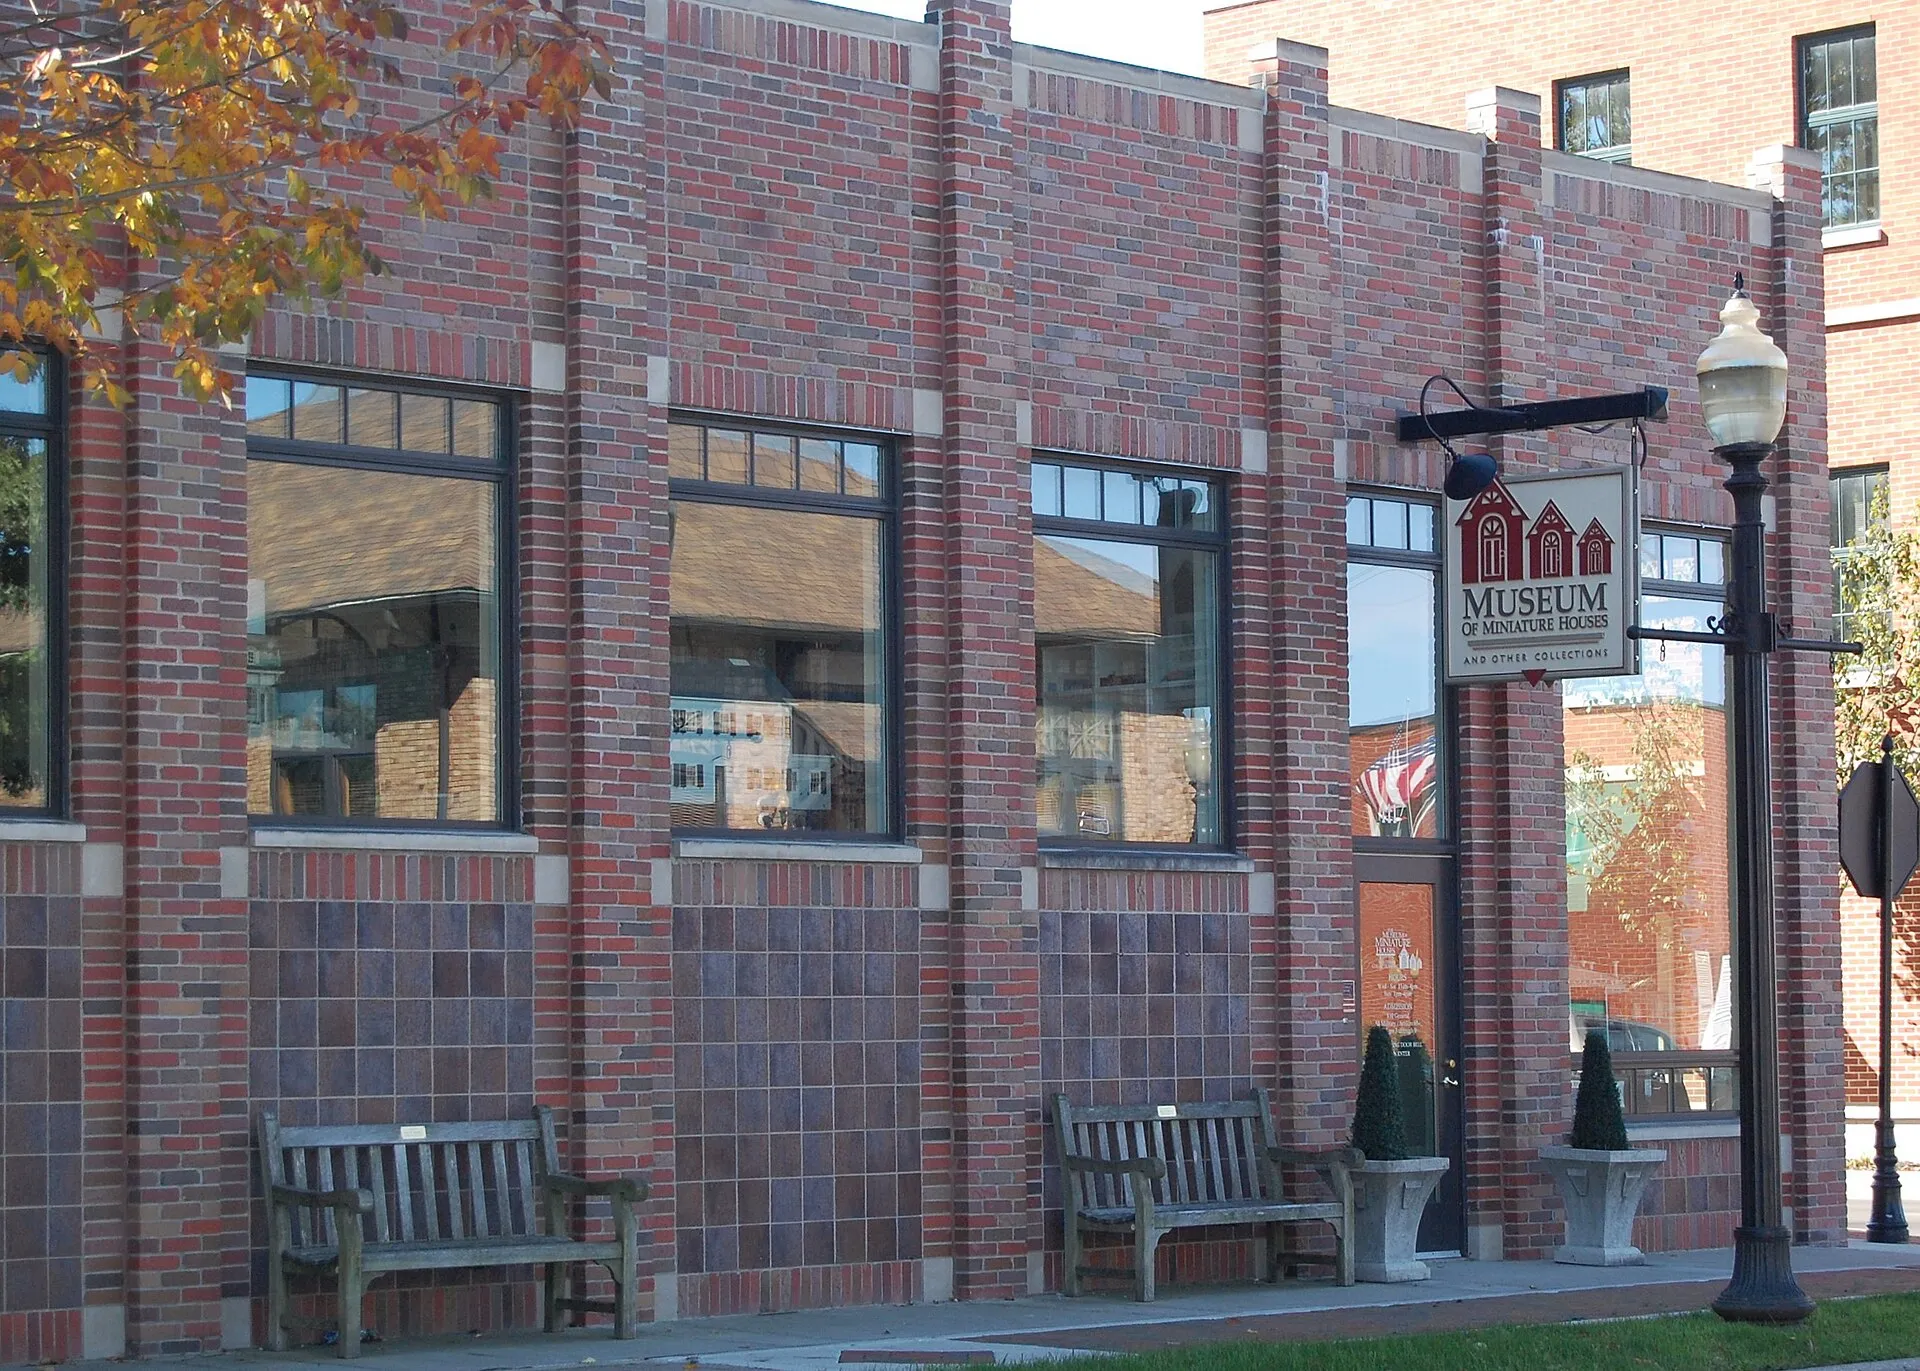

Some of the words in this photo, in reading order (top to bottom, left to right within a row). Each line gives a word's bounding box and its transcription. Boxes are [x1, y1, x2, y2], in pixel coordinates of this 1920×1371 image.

[1462, 583, 1608, 620] MUSEUM
[1462, 622, 1478, 636] OF
[1483, 618, 1554, 635] MINIATURE
[1559, 614, 1609, 631] HOUSES
[1463, 656, 1486, 665] AND
[1492, 653, 1528, 664] OTHER
[1534, 648, 1608, 661] COLLECTIONS
[1375, 937, 1411, 947] MINIATURE
